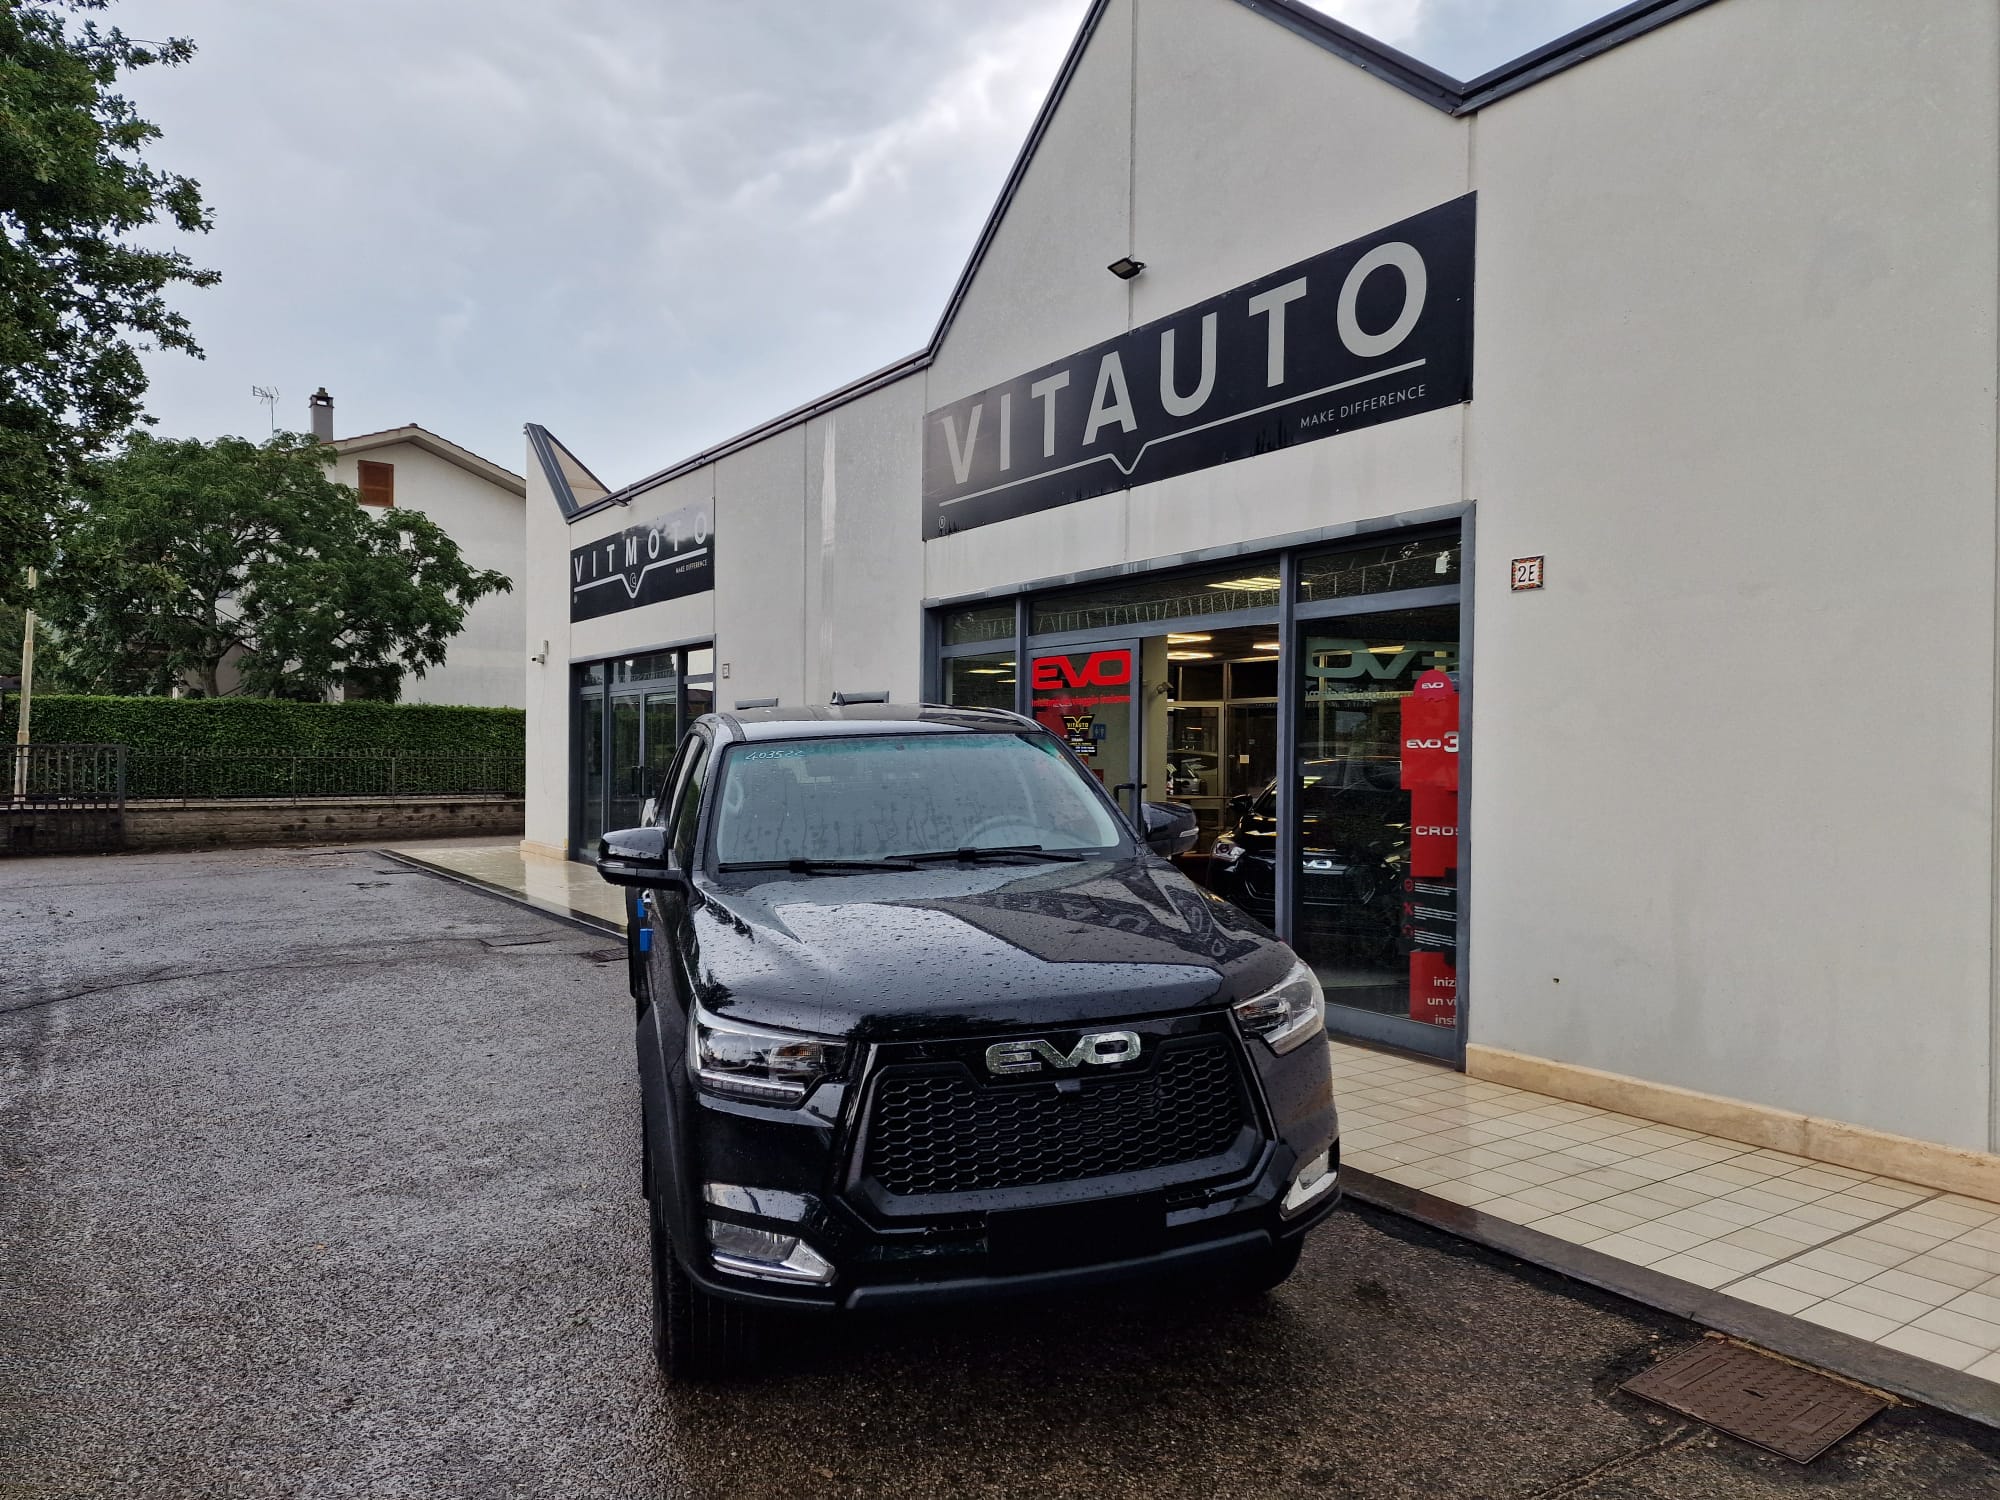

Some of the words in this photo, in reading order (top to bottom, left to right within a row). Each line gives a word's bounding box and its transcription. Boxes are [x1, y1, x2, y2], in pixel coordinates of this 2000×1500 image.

[942, 241, 1428, 485] VITAUTO
[1300, 408, 1335, 429] MAKE
[1340, 384, 1427, 418] DIFFERENCE
[574, 511, 707, 583] VITMOTO
[1518, 564, 1536, 583] 2E
[1031, 649, 1132, 690] EVO
[1406, 739, 1442, 749] EVO
[1415, 825, 1459, 836] CRO
[1427, 997, 1443, 1006] un
[985, 1031, 1141, 1074] EVO
